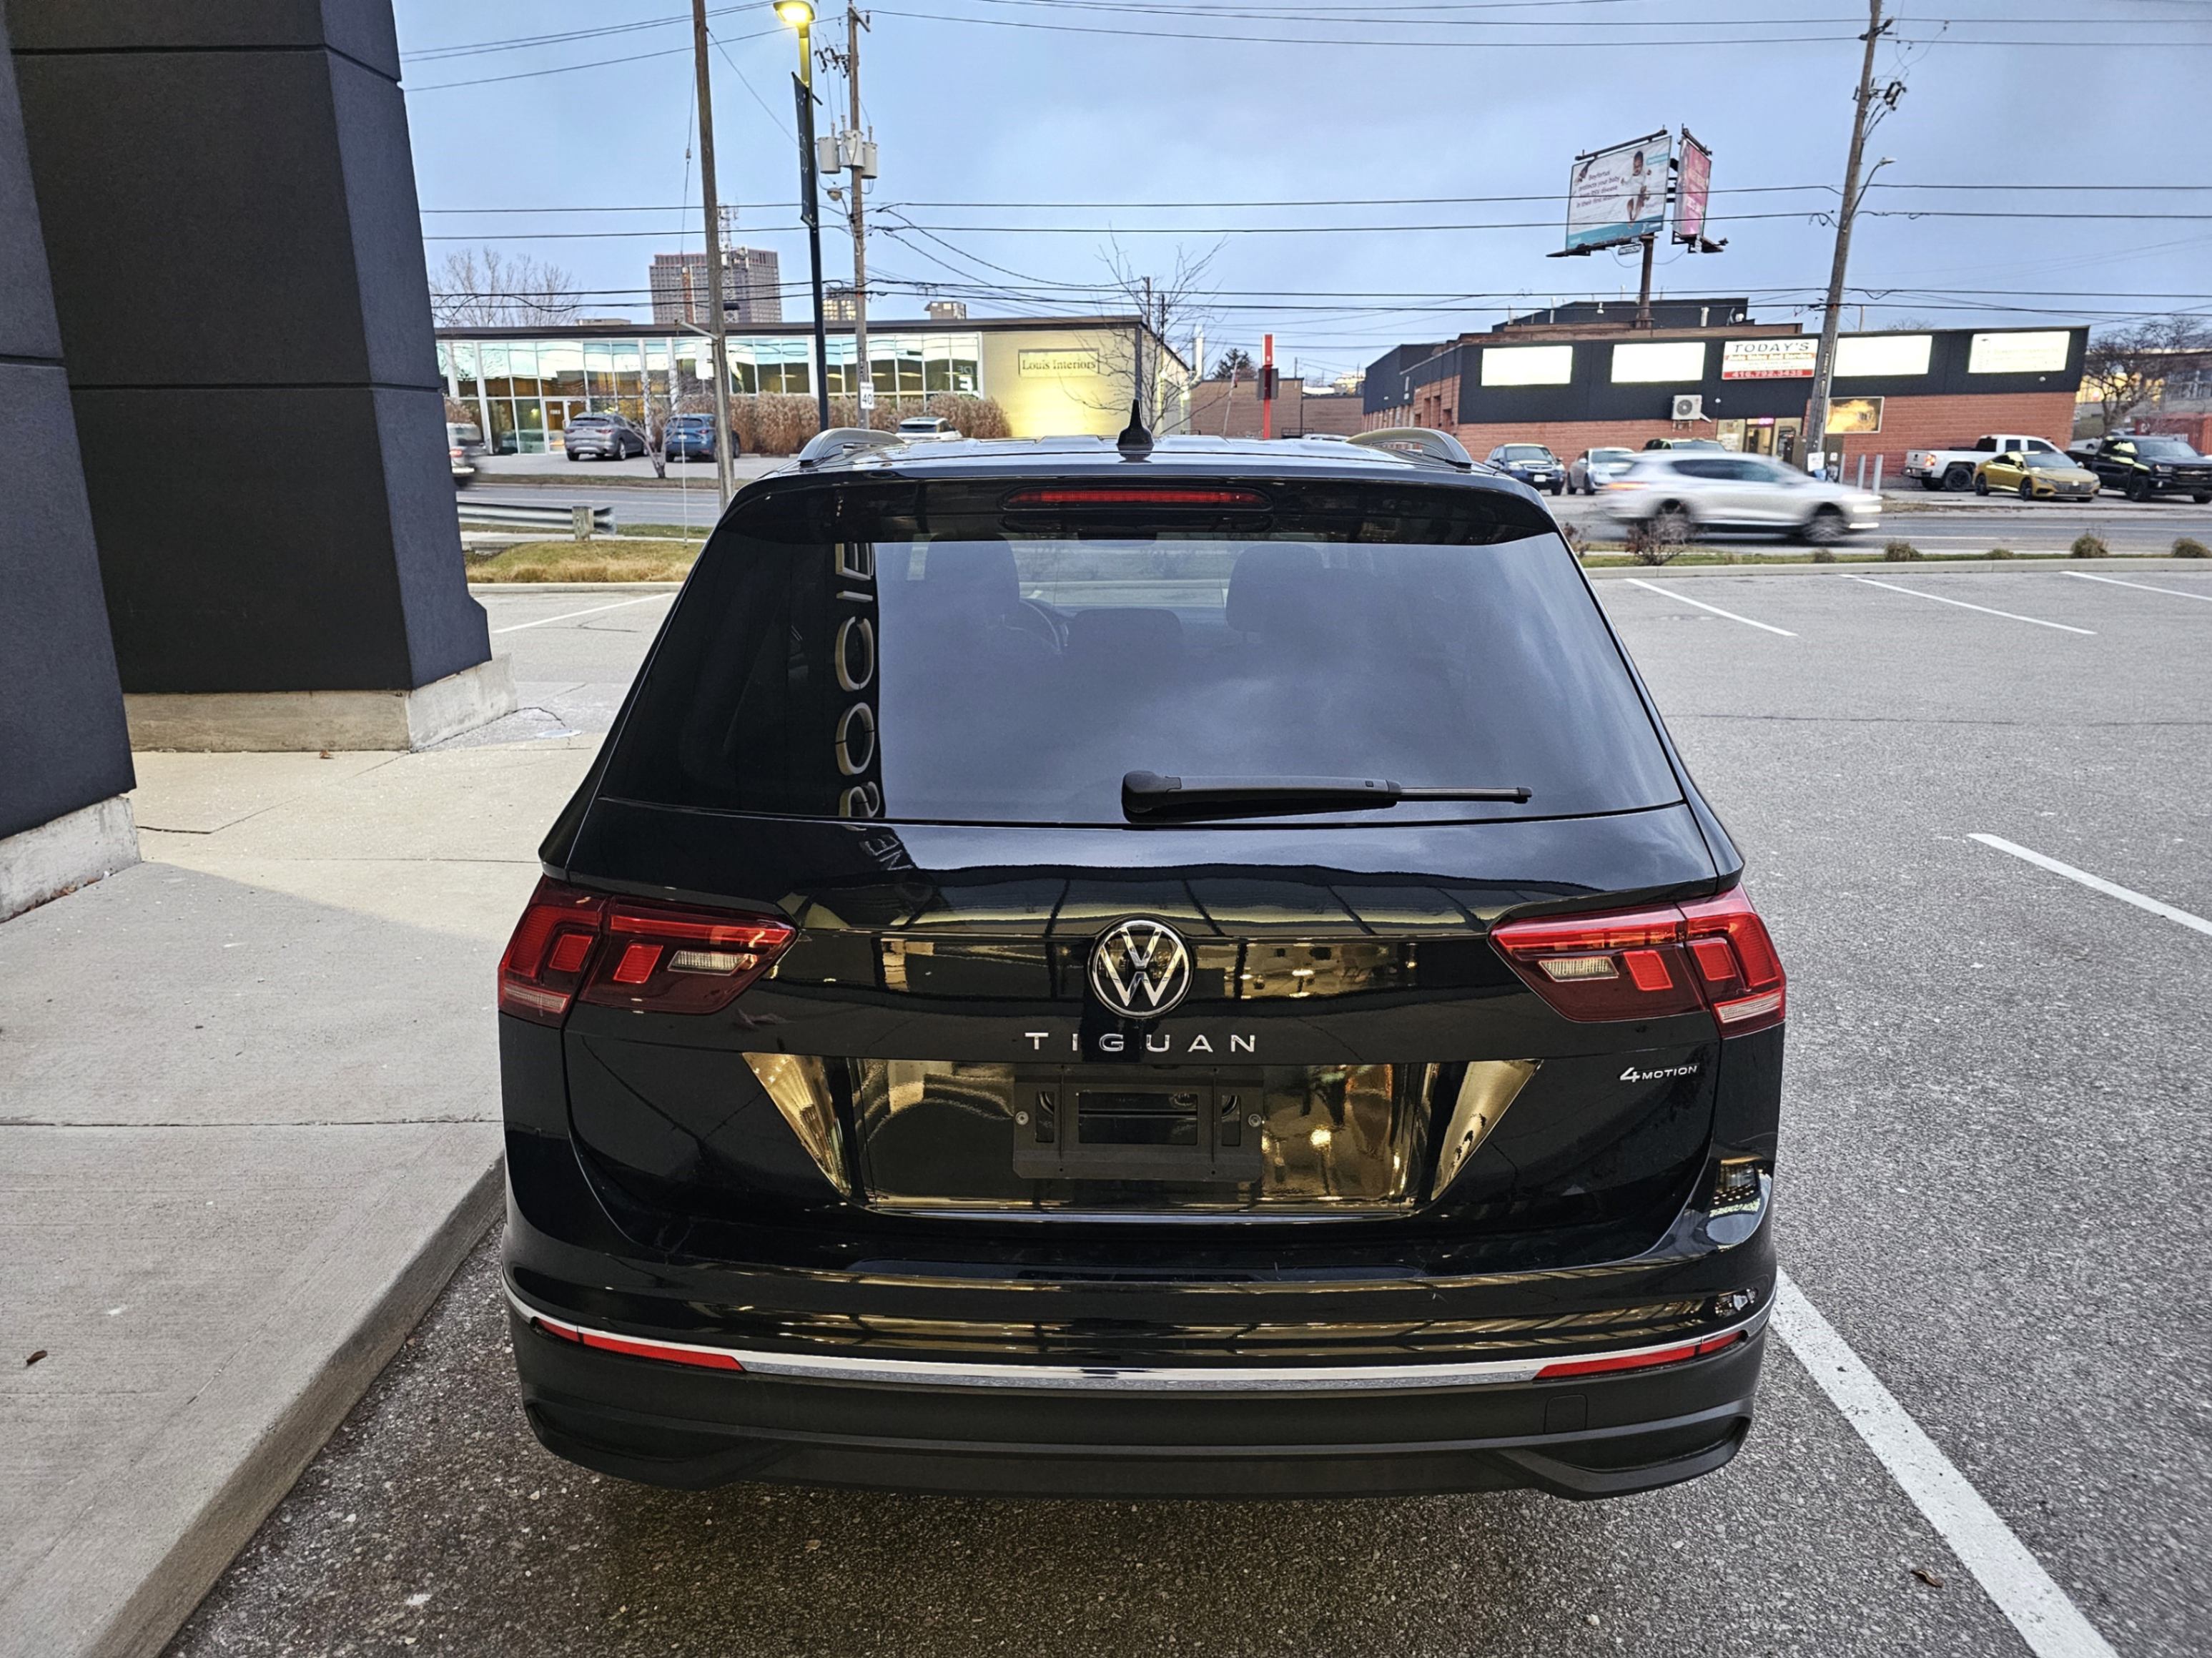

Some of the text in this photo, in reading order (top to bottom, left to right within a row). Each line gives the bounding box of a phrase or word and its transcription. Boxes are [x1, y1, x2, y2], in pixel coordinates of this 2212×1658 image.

[1734, 342, 1809, 352] TODAY'S
[1022, 358, 1096, 370] Louis Interiors
[861, 393, 873, 405] 40
[1024, 1032, 1256, 1052] TIGUAN
[1619, 1065, 1698, 1082] 4MOTION
